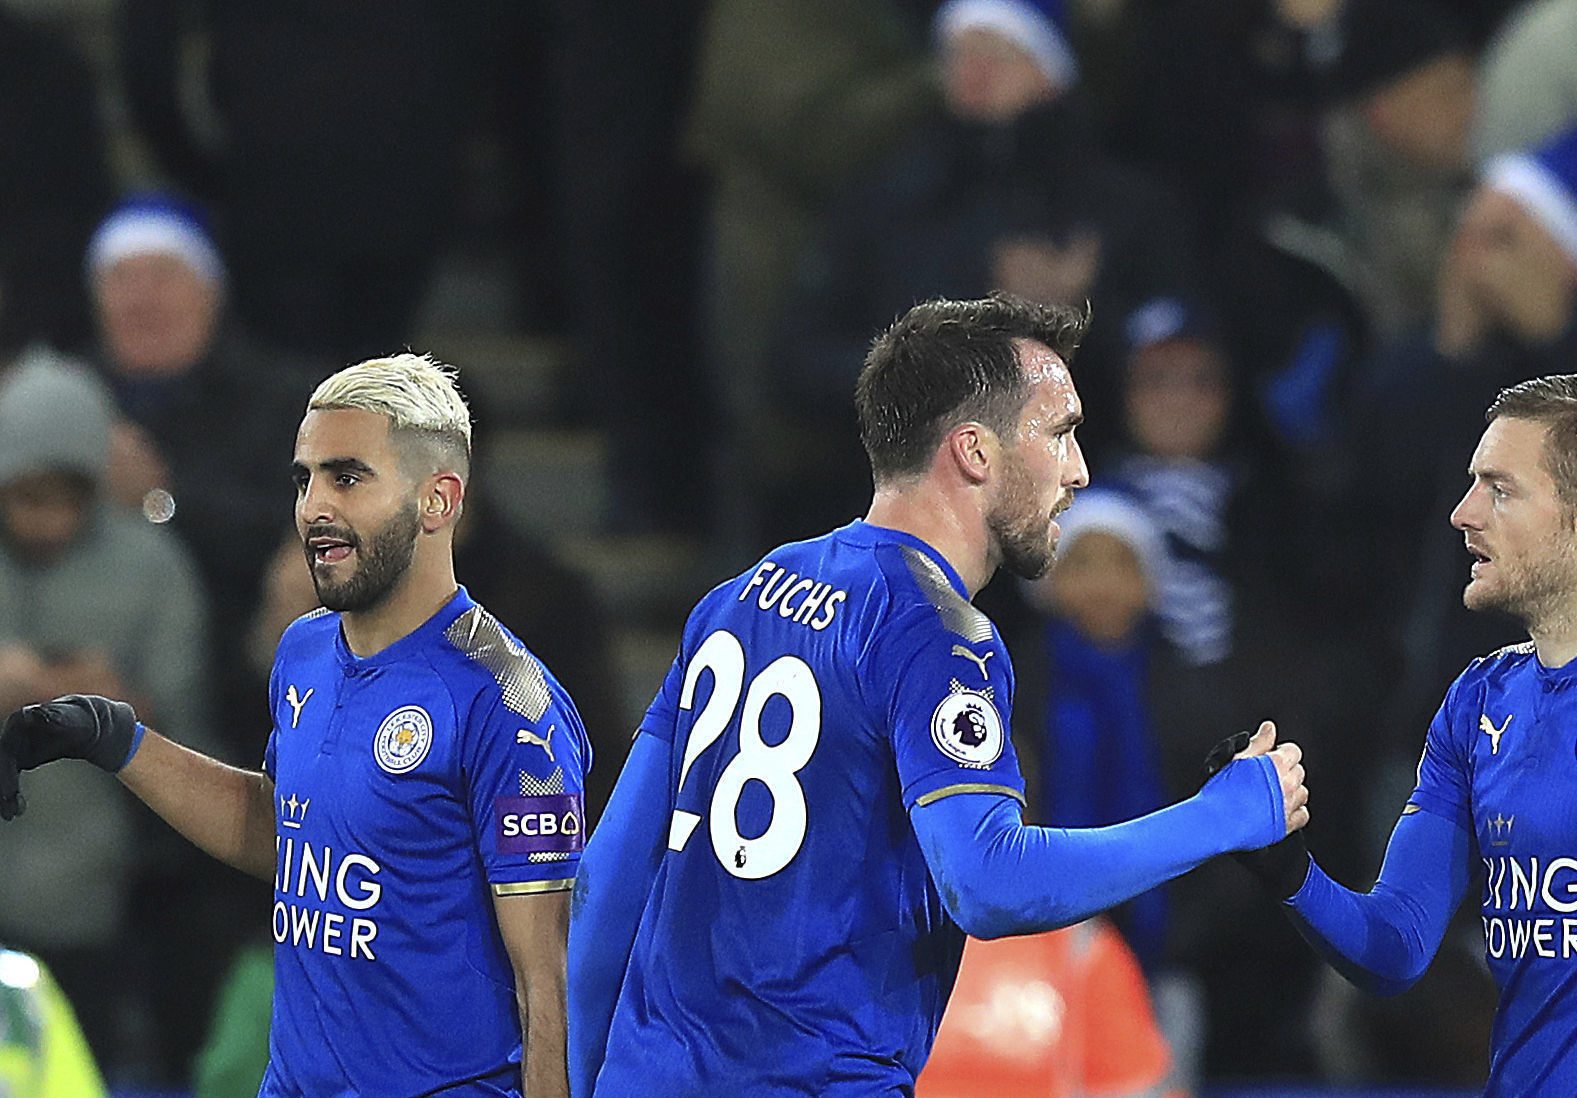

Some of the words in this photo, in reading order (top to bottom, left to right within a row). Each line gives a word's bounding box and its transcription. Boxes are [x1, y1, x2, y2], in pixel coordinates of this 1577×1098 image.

[737, 561, 847, 631] FUCHS
[667, 630, 822, 880] 28
[503, 813, 558, 836] SCB
[275, 835, 381, 910] ING
[272, 900, 378, 961] OWER
